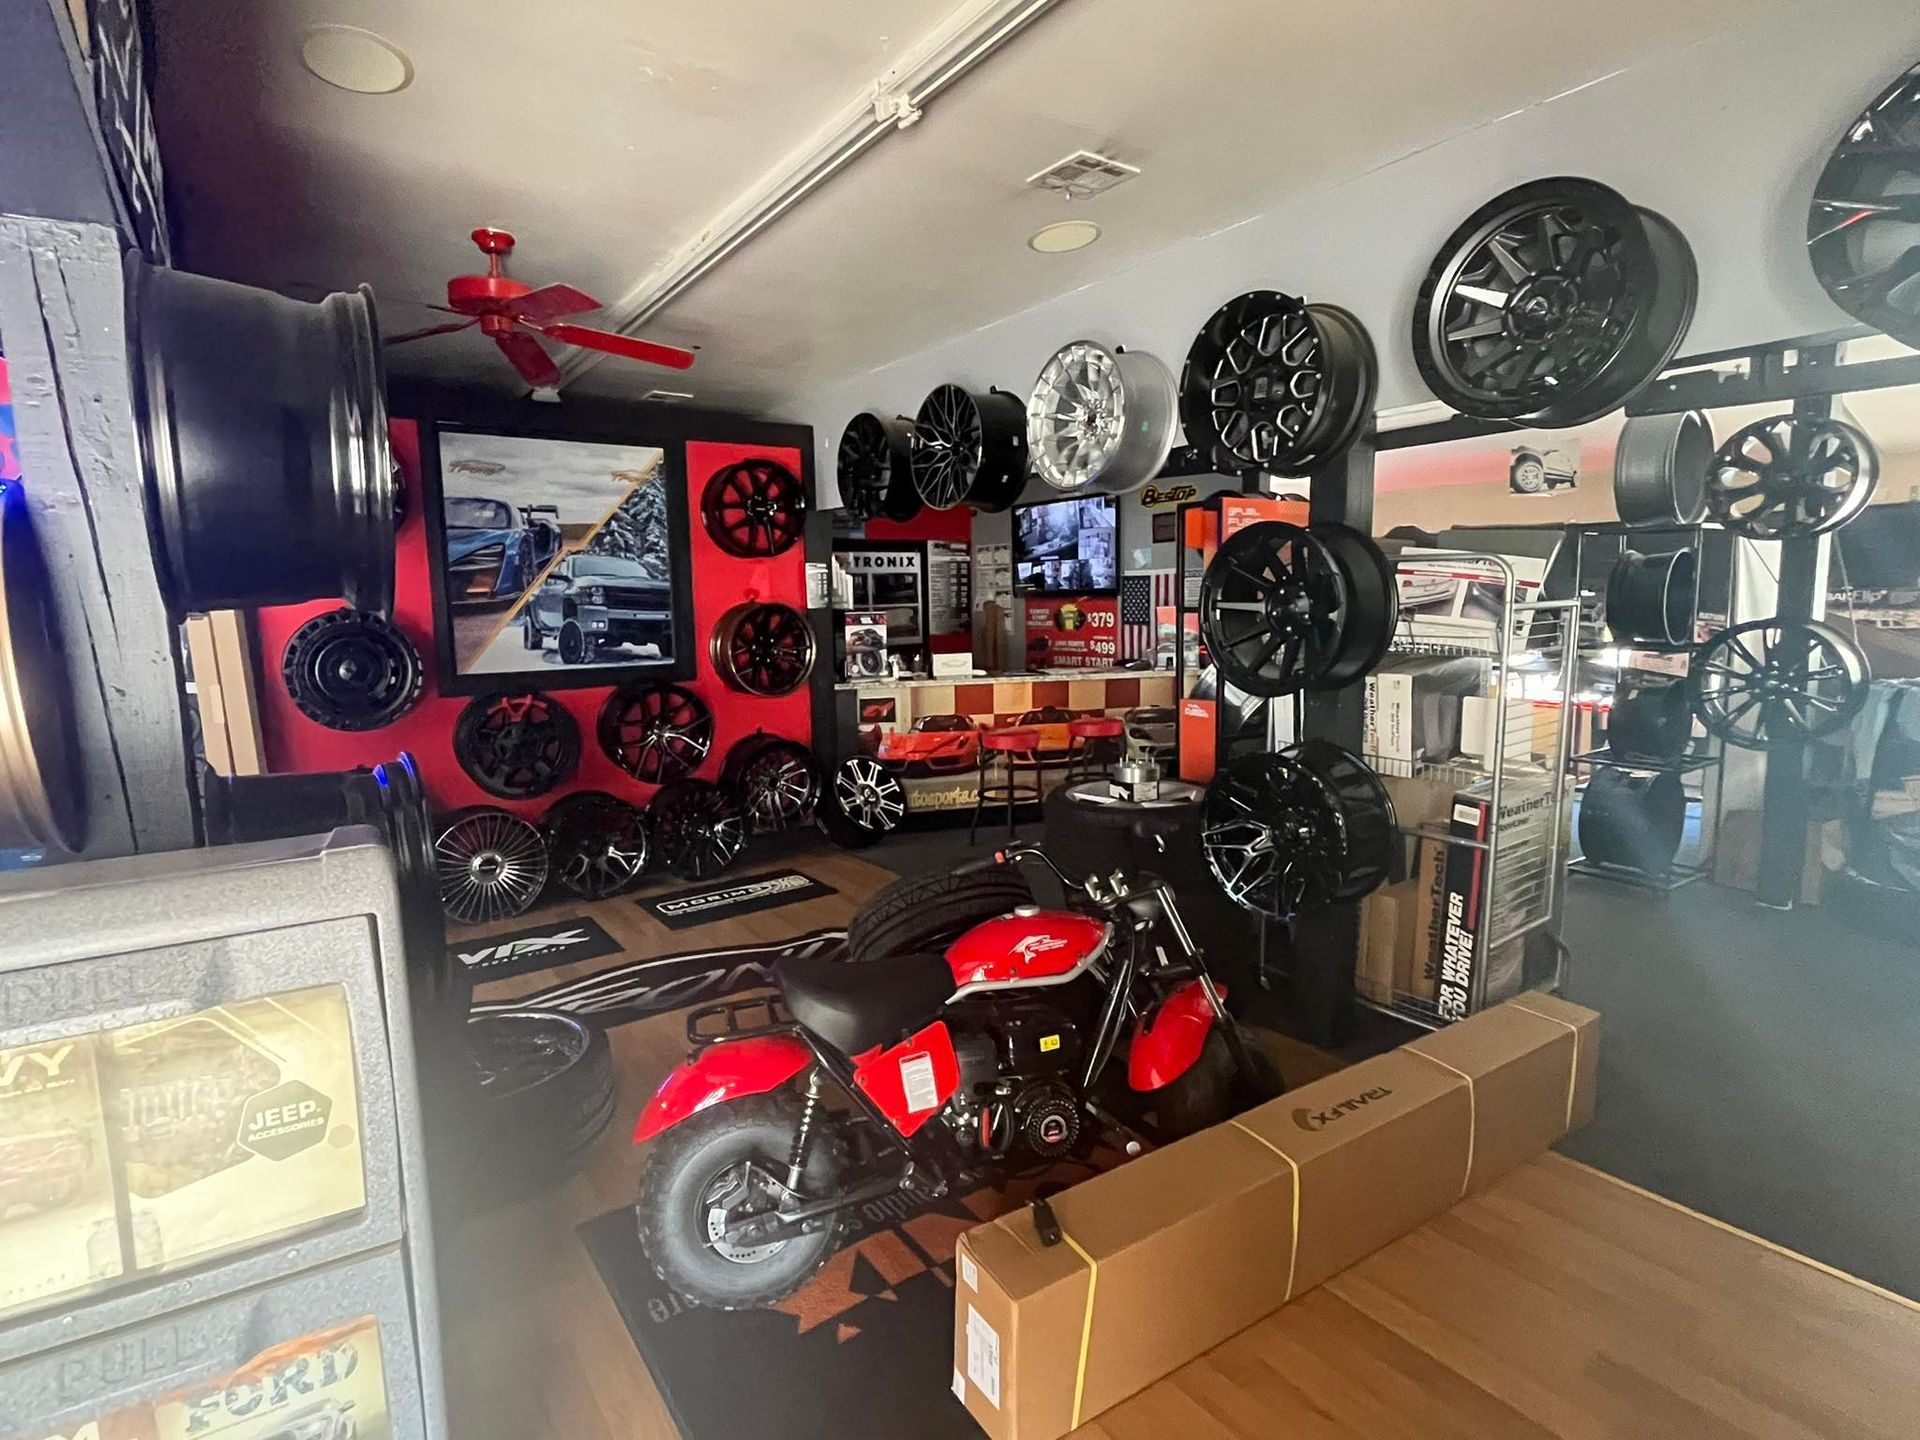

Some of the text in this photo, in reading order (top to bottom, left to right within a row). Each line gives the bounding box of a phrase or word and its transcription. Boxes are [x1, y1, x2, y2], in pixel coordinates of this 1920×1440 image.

[853, 556, 915, 568] TRONIX
[1087, 612, 1114, 628] $379
[1089, 640, 1115, 655] $499
[1084, 656, 1114, 668] START
[1442, 891, 1464, 982] WHATEVER
[1455, 929, 1474, 988] DRIVE!
[248, 1099, 317, 1131] JEEP
[247, 1116, 325, 1142] ACCESSORIES
[184, 1341, 360, 1434] FORD
